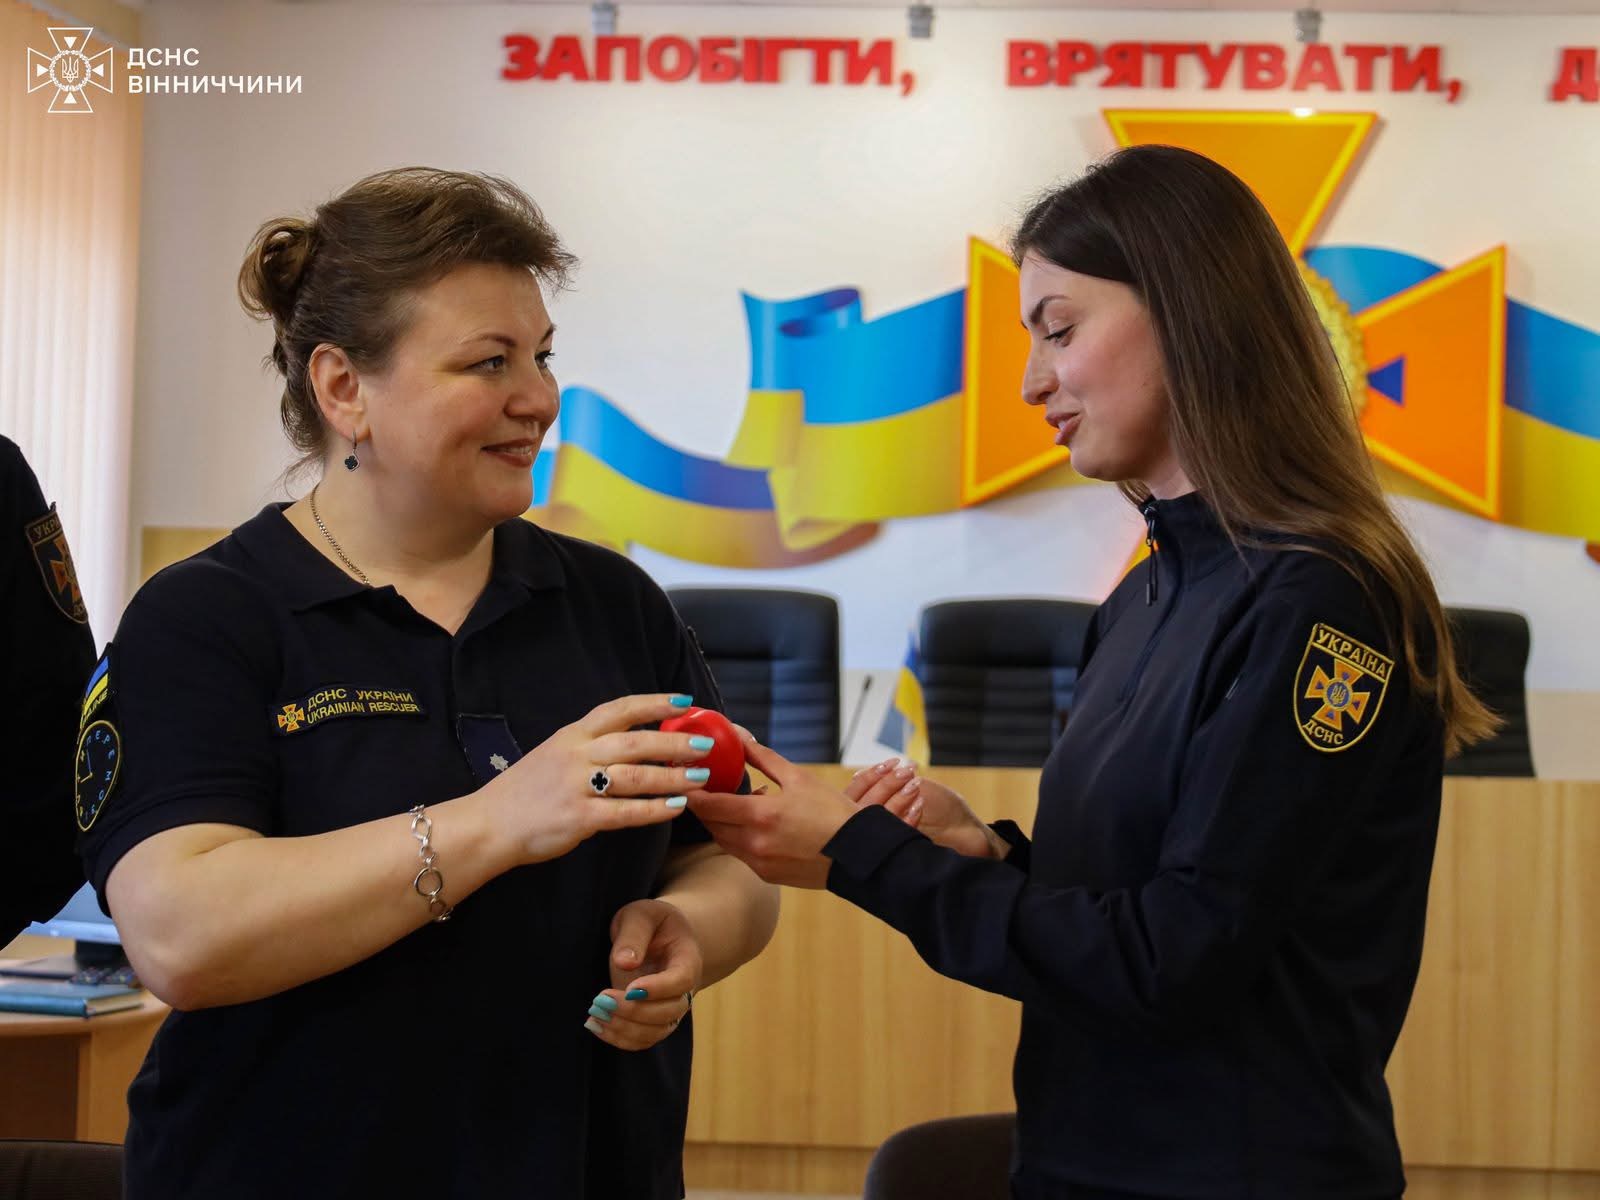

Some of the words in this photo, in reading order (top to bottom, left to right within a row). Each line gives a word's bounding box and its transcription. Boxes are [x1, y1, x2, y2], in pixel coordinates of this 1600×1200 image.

[501, 34, 915, 95] ЗАПОБІГТИ,
[1007, 39, 1464, 102] ВРЯТУВАТИ,
[1316, 629, 1386, 678] УКРАЇНА
[306, 702, 365, 725] UKRAINIAN
[369, 701, 420, 713] RESCUER
[307, 687, 348, 712] ДСНС
[356, 689, 414, 703] УКРАЇНИ
[1302, 718, 1344, 745] ДСНС
